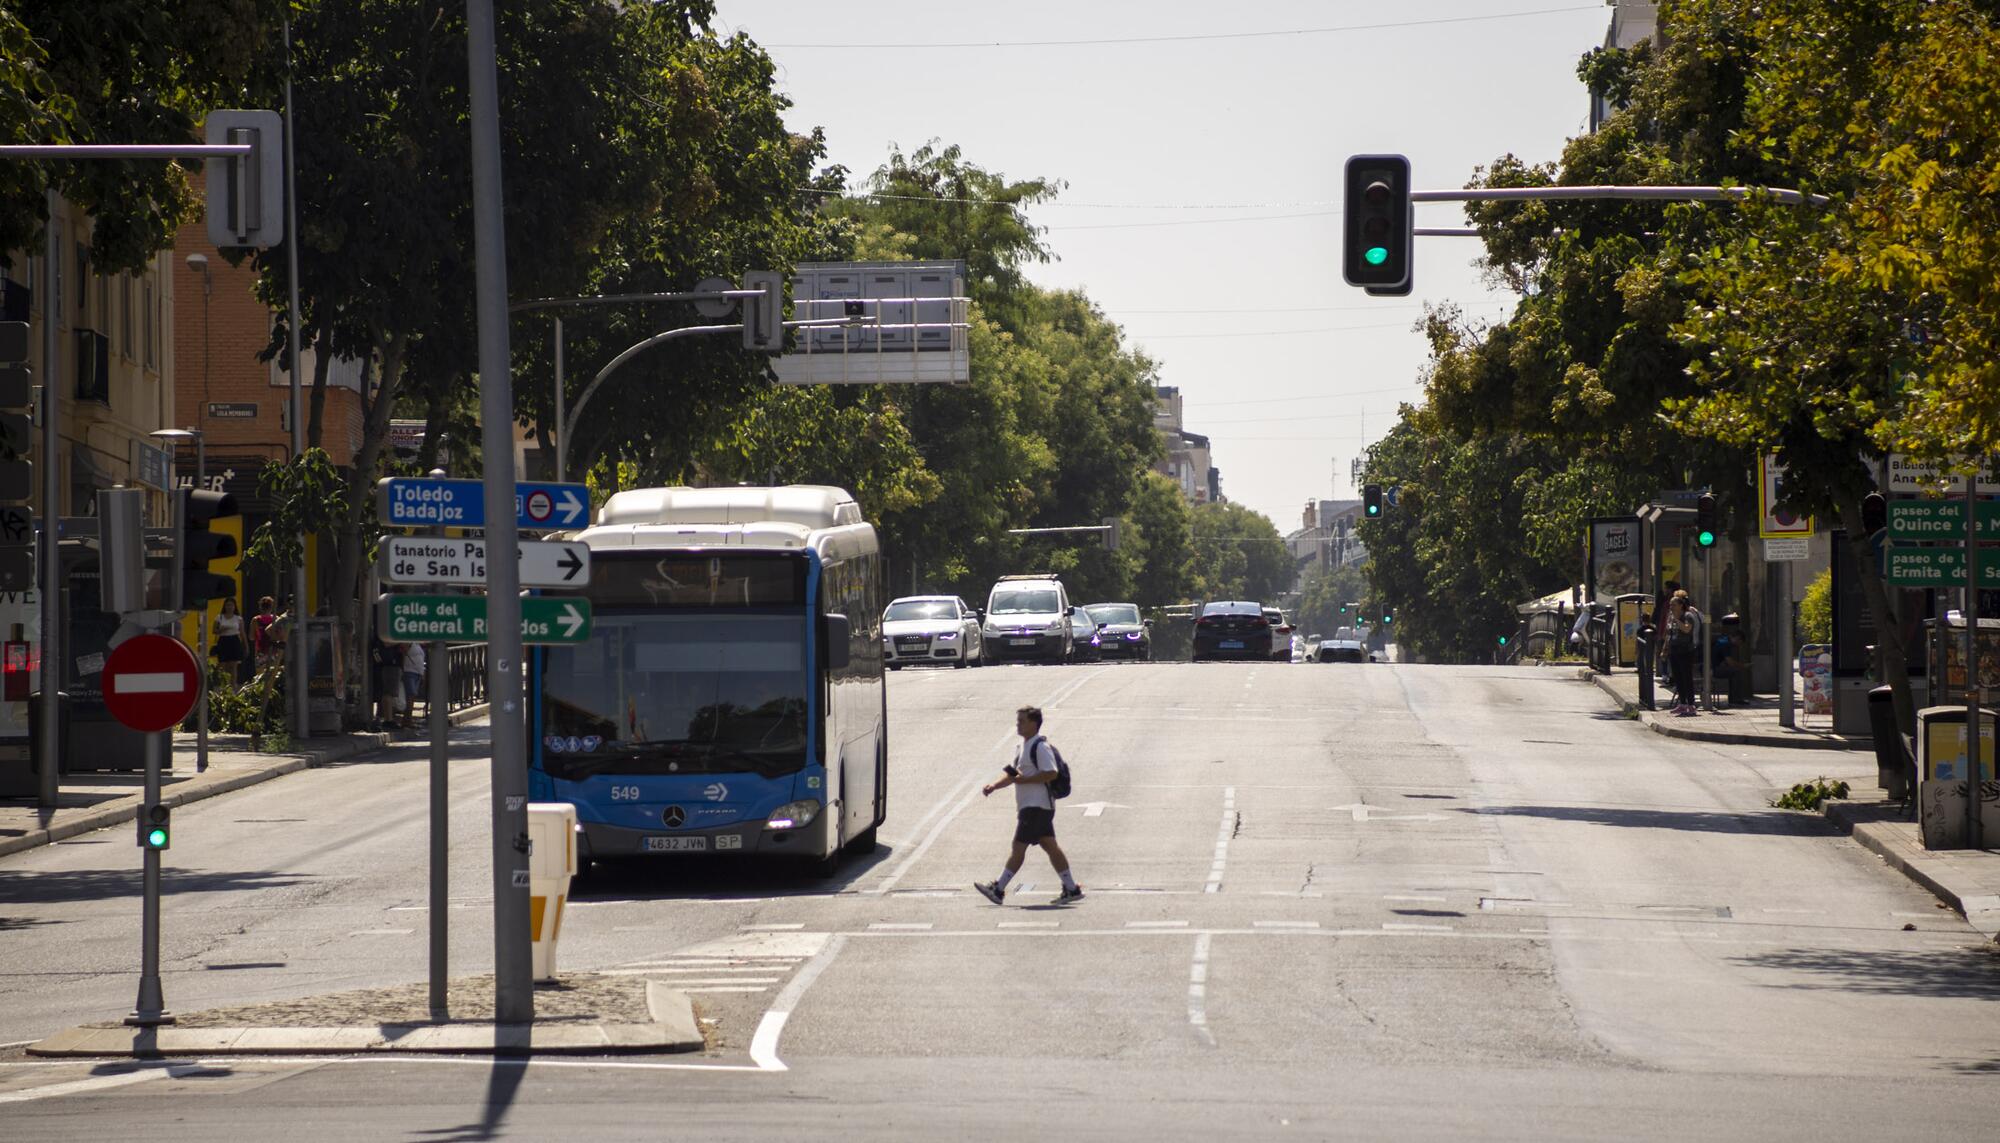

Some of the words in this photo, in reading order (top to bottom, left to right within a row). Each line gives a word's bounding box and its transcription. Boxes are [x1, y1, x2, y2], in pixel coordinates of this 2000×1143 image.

[394, 484, 454, 502] Toledo
[394, 502, 463, 522] Badajoz
[1892, 506, 1932, 517] paseo
[1938, 505, 1959, 516] del
[1892, 517, 1953, 532] Quince
[1604, 534, 1631, 550] BAGELS
[394, 543, 456, 558] tanatorio
[1892, 554, 1931, 565] paseo
[1938, 553, 1954, 564] de
[394, 559, 415, 575] de
[427, 560, 460, 576] San
[1892, 566, 1942, 578] Ermita
[393, 602, 428, 615] calle
[436, 602, 458, 616] del
[393, 616, 463, 635] General
[611, 785, 640, 800] 549
[650, 838, 679, 850] 4632
[683, 838, 705, 849] JVN
